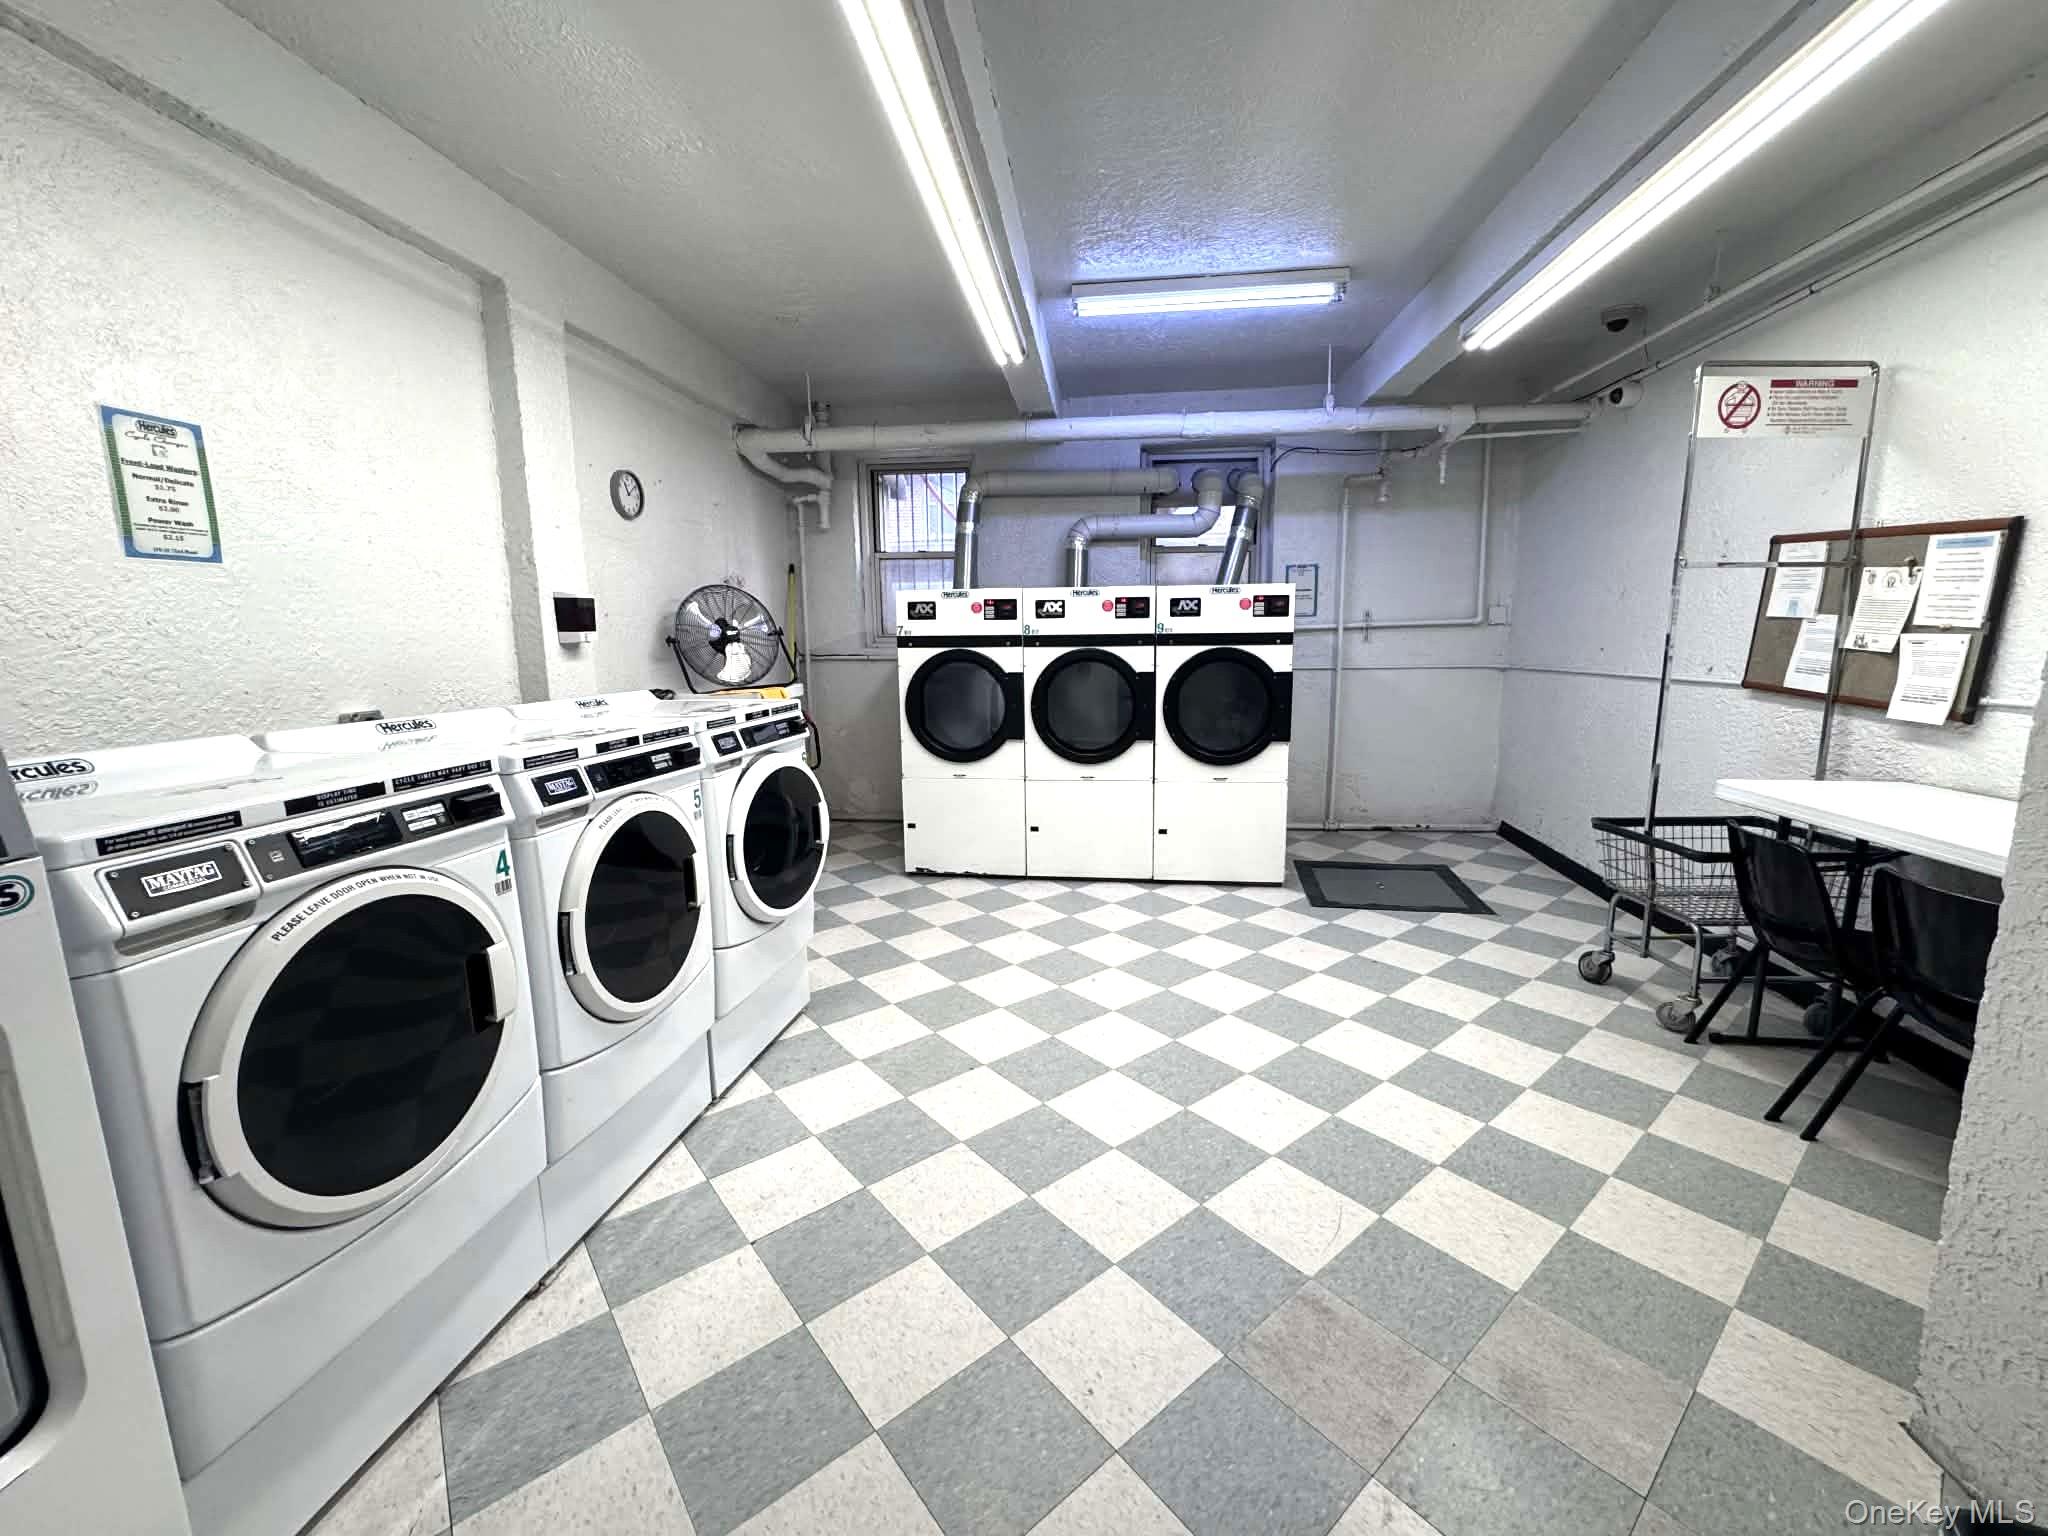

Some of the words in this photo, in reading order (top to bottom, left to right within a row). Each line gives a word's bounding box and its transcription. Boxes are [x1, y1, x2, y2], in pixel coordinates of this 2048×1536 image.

[1795, 380, 1836, 388] WARNING
[135, 419, 178, 438] Hercules
[132, 472, 195, 489] Normal/Delicate
[145, 494, 168, 504] Extra
[173, 519, 195, 528] Wash
[896, 625, 904, 635] 7
[1023, 624, 1031, 635] 8
[1156, 622, 1165, 633] 9
[379, 719, 434, 733] Hercules
[11, 760, 88, 781] rcules
[394, 775, 416, 785] CYCLE
[438, 769, 450, 777] MAY
[316, 789, 342, 801] DISPLAY
[693, 789, 702, 808] 5
[496, 849, 511, 877] 4
[146, 862, 217, 891] MAYTAG
[271, 913, 306, 942] PLEASE
[303, 896, 331, 917] LEAVE
[329, 884, 356, 900] DOOR
[355, 876, 380, 889] OPEN
[380, 874, 402, 882] WHEN
